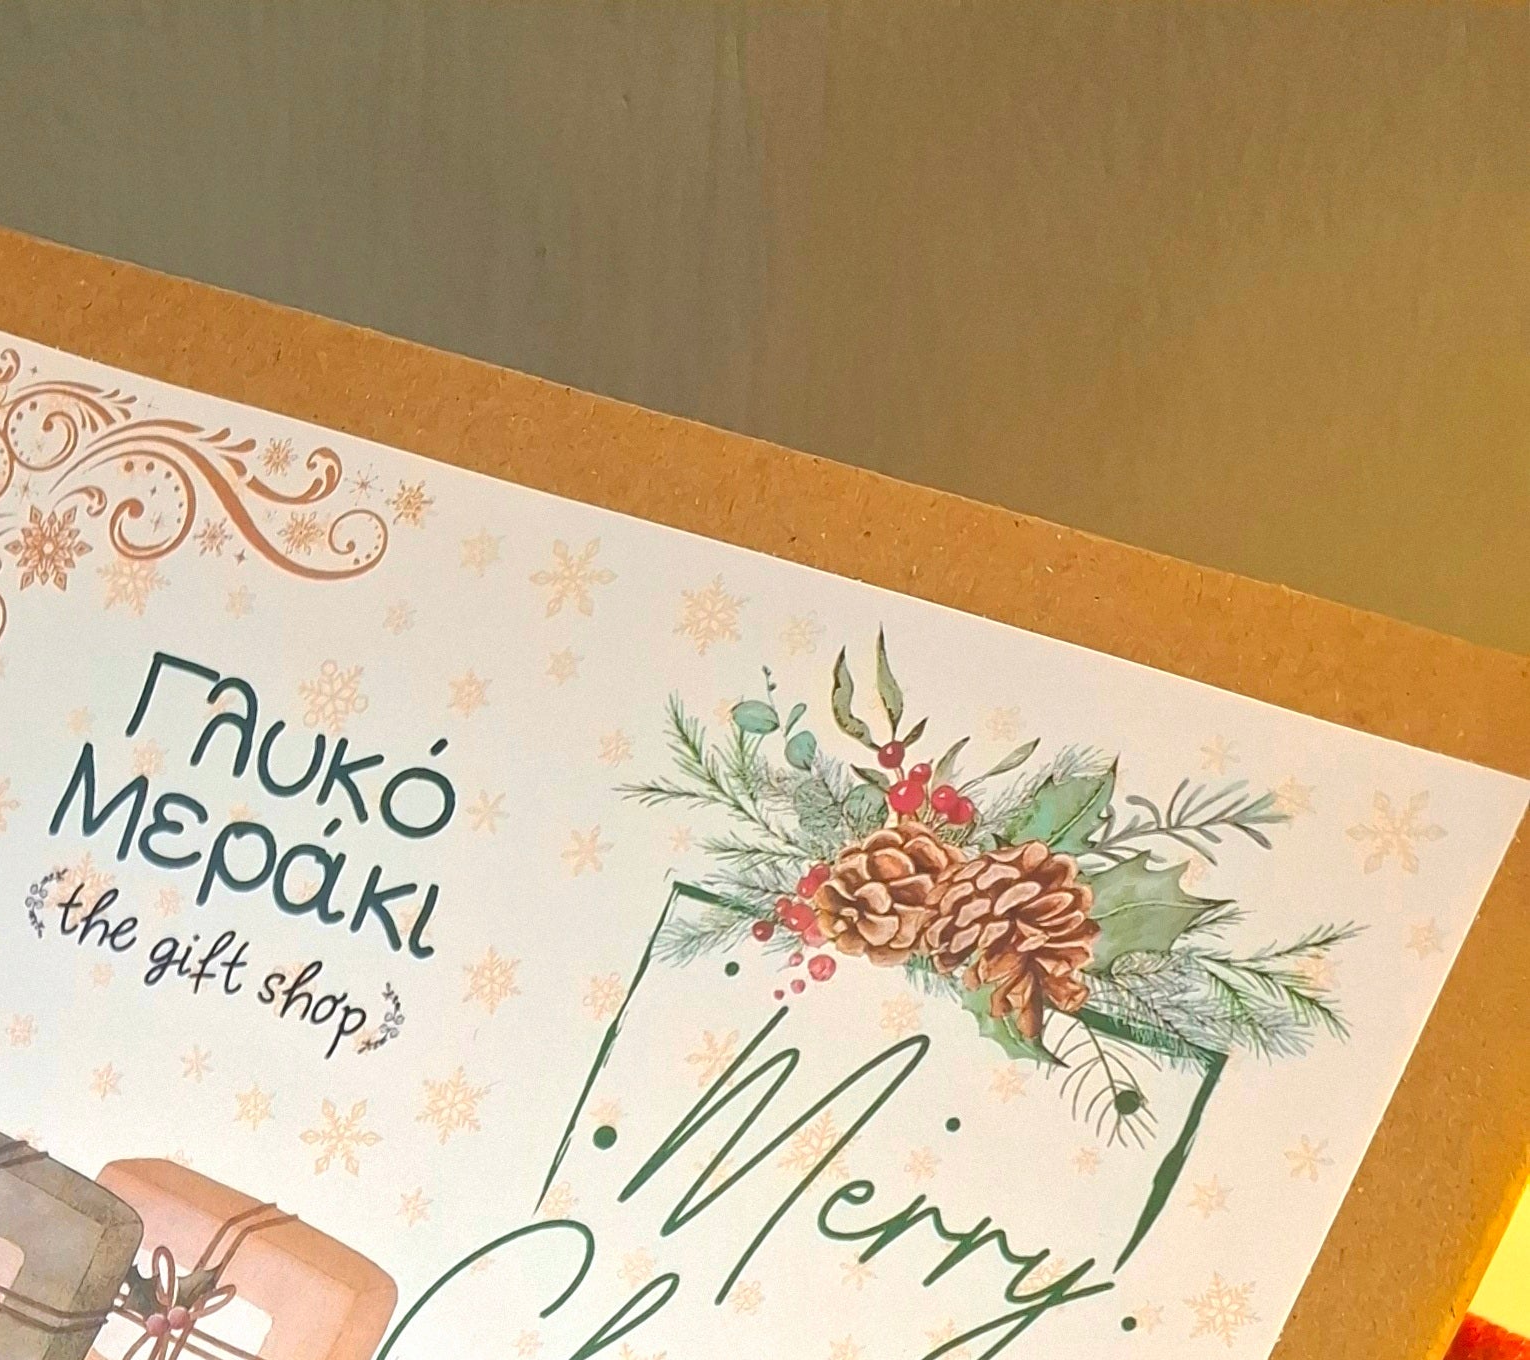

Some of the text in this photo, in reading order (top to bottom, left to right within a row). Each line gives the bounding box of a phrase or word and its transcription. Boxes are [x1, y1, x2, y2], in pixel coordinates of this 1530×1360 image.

[125, 651, 457, 839] Γλυκό
[48, 742, 440, 959] Μεράκι
[56, 883, 367, 1060] the gift shop
